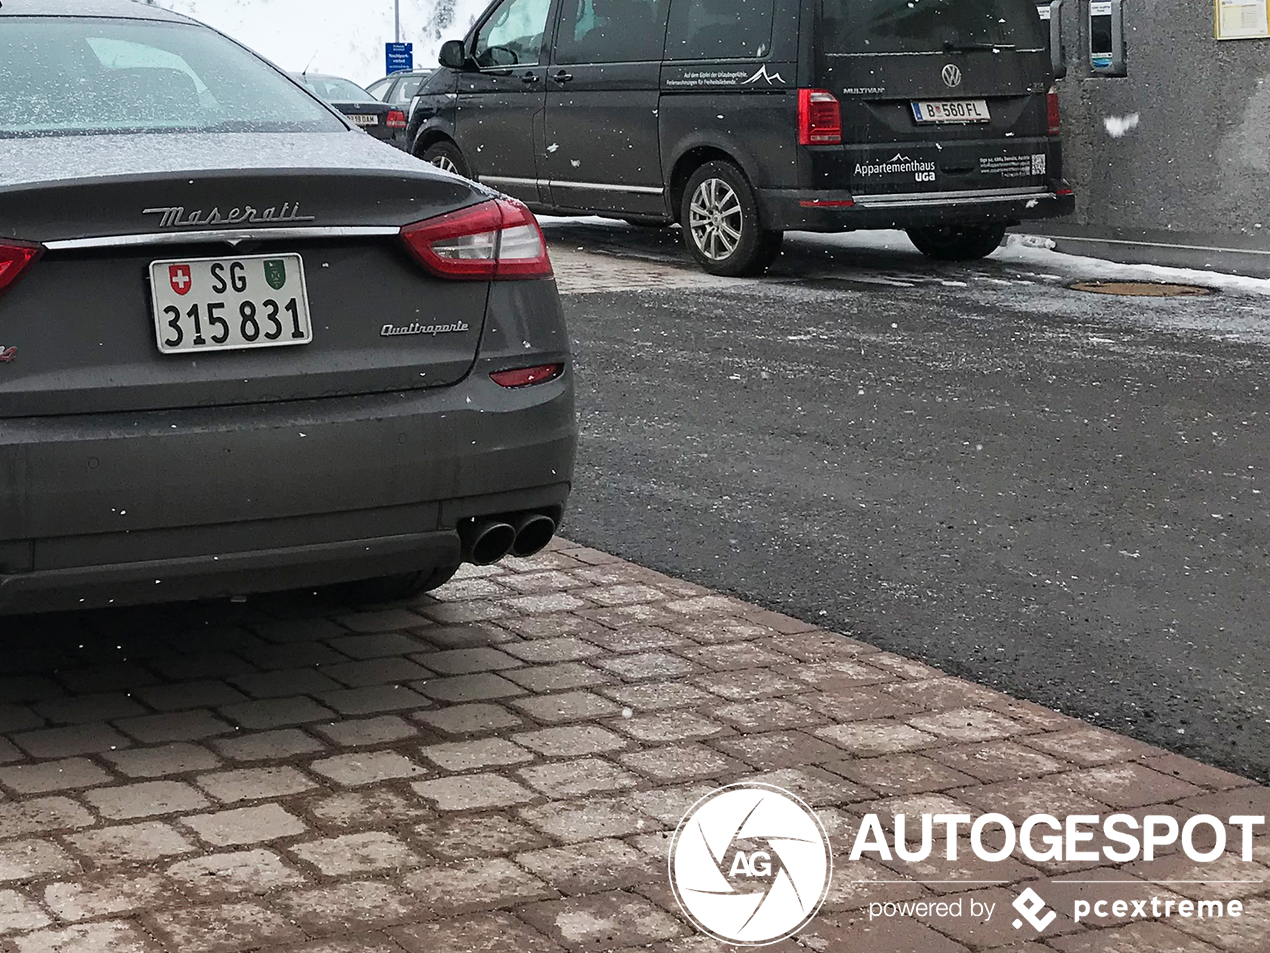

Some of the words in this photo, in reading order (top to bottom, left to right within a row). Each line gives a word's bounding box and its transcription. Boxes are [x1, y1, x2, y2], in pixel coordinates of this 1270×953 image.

[926, 104, 935, 118] B
[942, 103, 965, 117] 560
[966, 103, 982, 116] FL
[854, 160, 935, 177] Appartementhaus
[142, 201, 316, 227] Maserati
[210, 261, 247, 294] SG
[380, 320, 469, 337] Quattroporte
